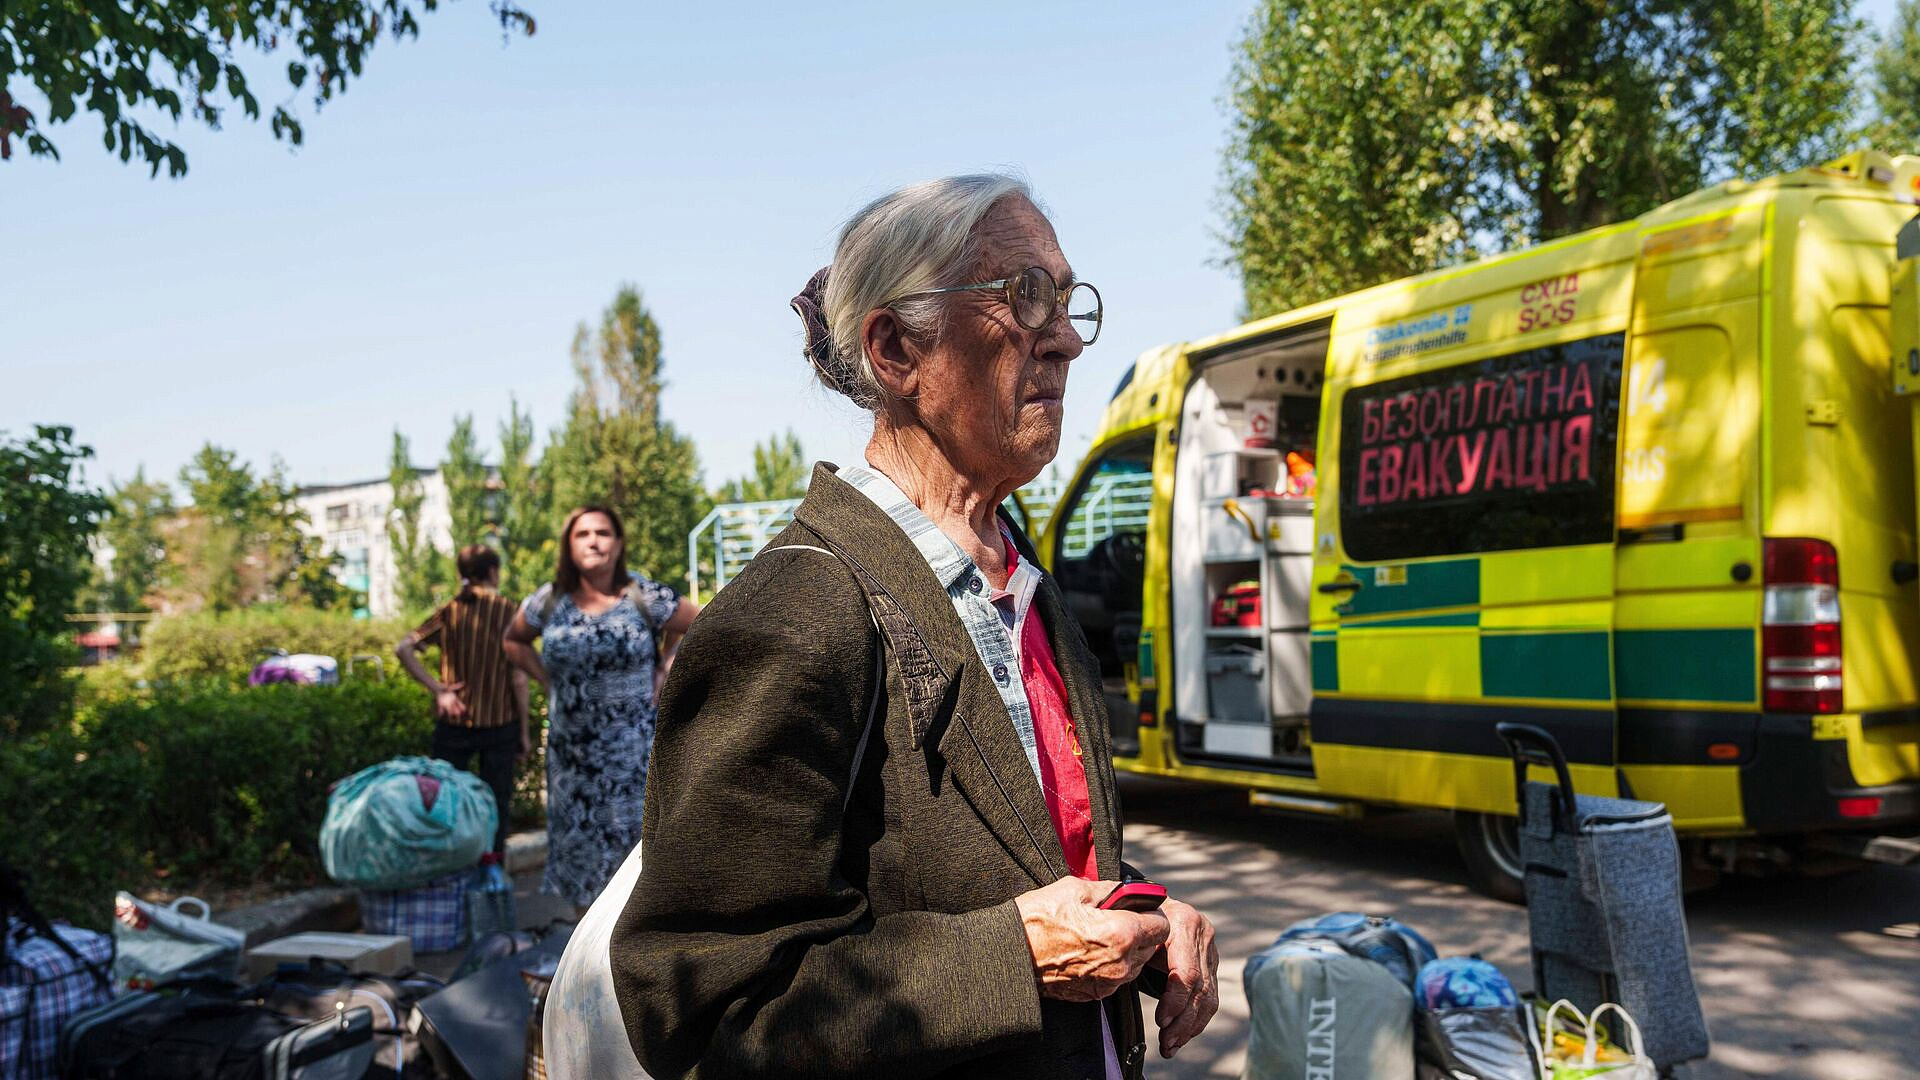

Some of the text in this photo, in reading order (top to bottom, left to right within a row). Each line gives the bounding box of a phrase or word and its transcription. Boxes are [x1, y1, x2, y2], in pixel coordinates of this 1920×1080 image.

[1519, 300, 1576, 333] SOS
[1521, 274, 1579, 303] СХІД
[1361, 362, 1594, 445] БЕЗОПЛАТНА
[1357, 415, 1592, 506] ЕВАКУАЦІЯ
